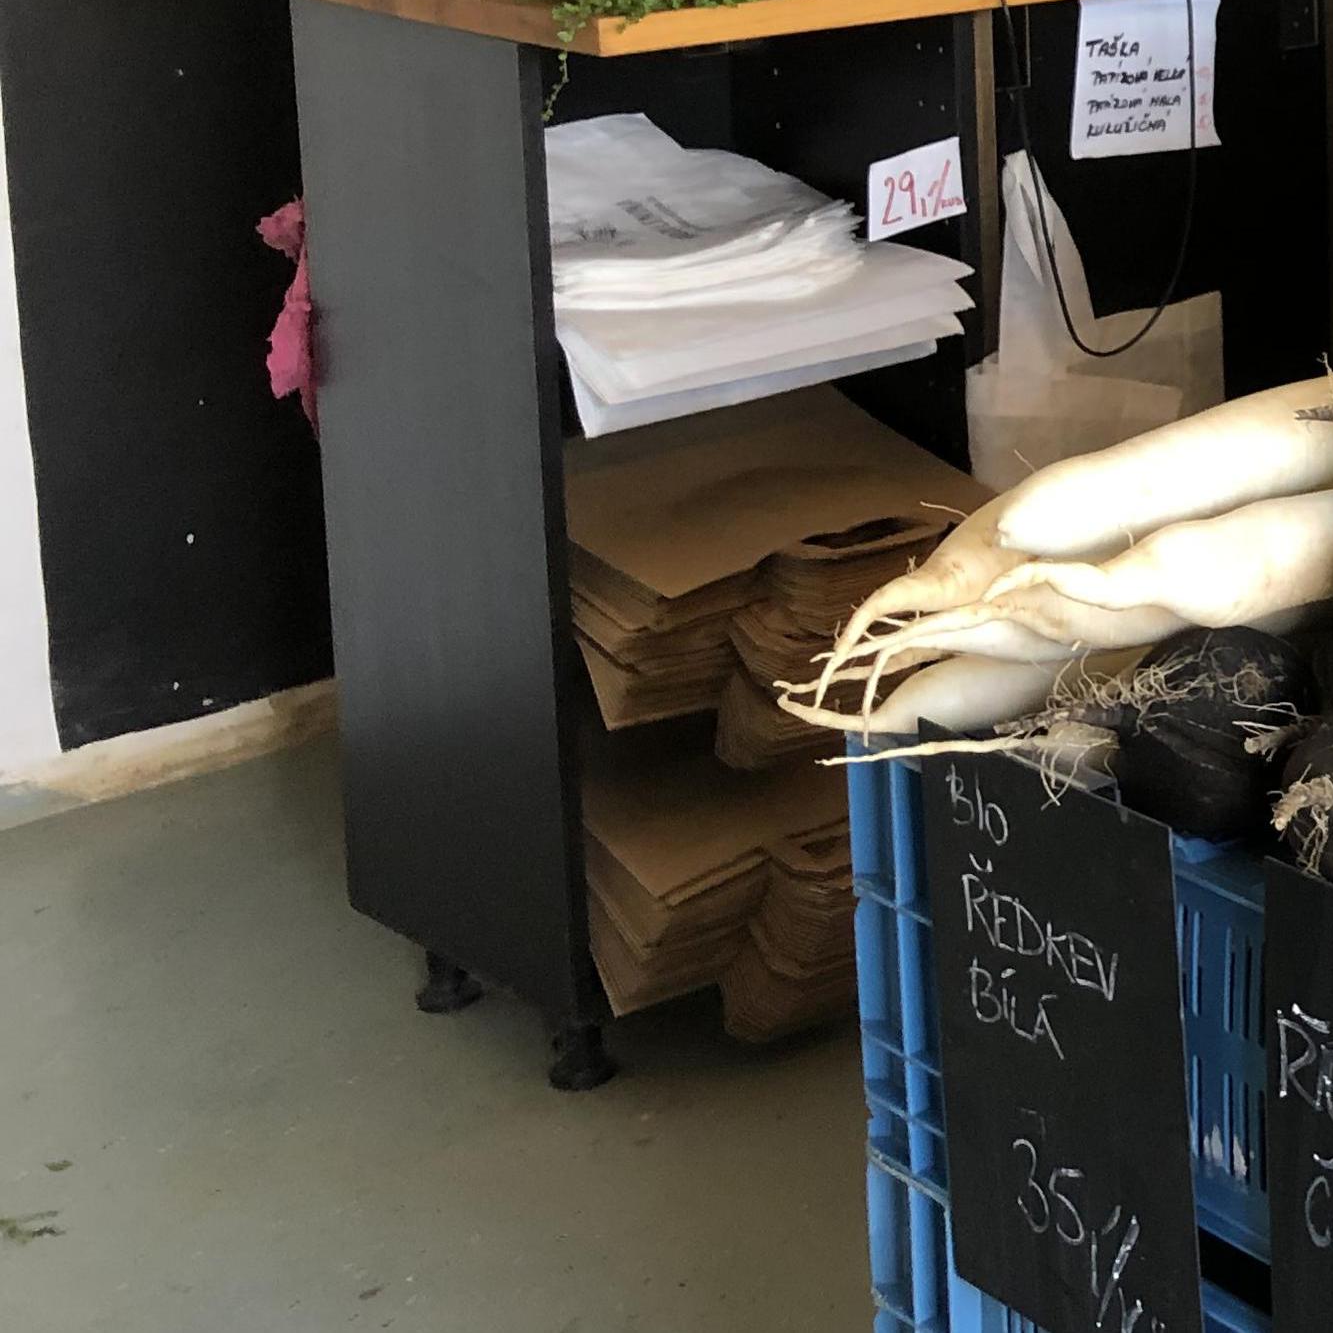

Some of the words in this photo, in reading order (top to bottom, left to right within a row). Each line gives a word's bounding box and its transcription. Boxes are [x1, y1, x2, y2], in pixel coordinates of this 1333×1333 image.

[1085, 32, 1140, 58] TAŠKA
[946, 763, 1009, 847] BIO
[961, 853, 1120, 1002] ŘEDKEV
